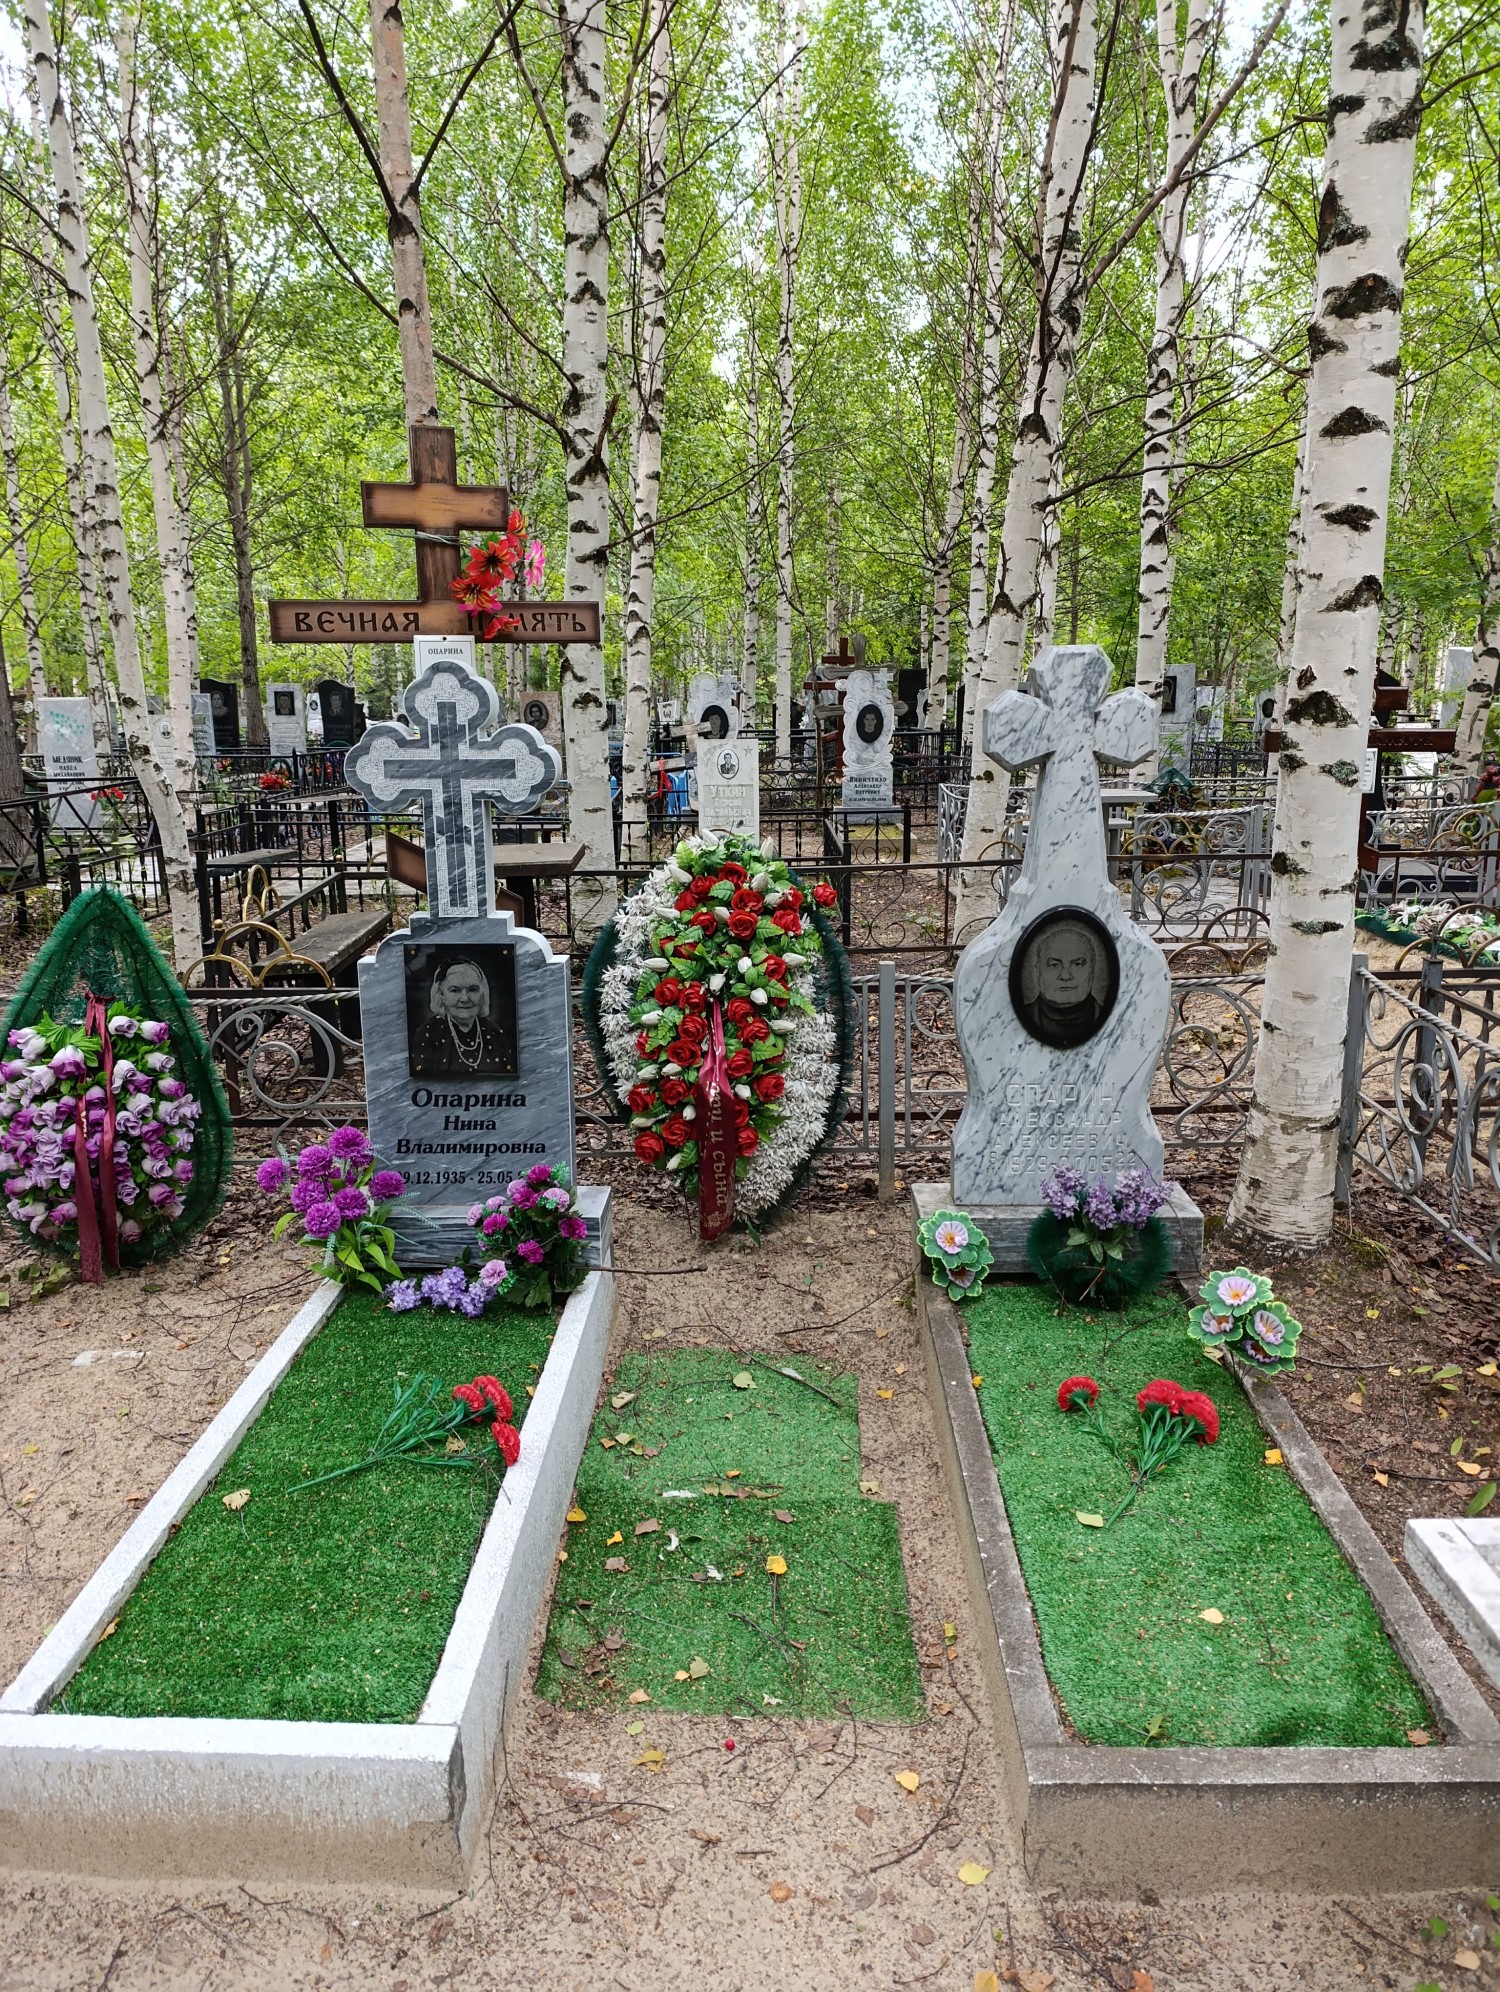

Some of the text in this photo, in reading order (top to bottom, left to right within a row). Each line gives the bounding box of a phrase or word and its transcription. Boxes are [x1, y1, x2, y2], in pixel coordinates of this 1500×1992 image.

[467, 612, 587, 633] ПМЯТЬ
[411, 1088, 527, 1111] Опарина
[443, 1115, 497, 1131] Нина
[1000, 1110, 1123, 1128] АЛЕКСАНДР
[396, 1138, 546, 1157] Владимировна
[994, 1133, 1128, 1150] АЛЕКСЕЕВИЧ
[399, 1171, 466, 1184] 9.12.1935
[712, 1150, 727, 1207] сына
